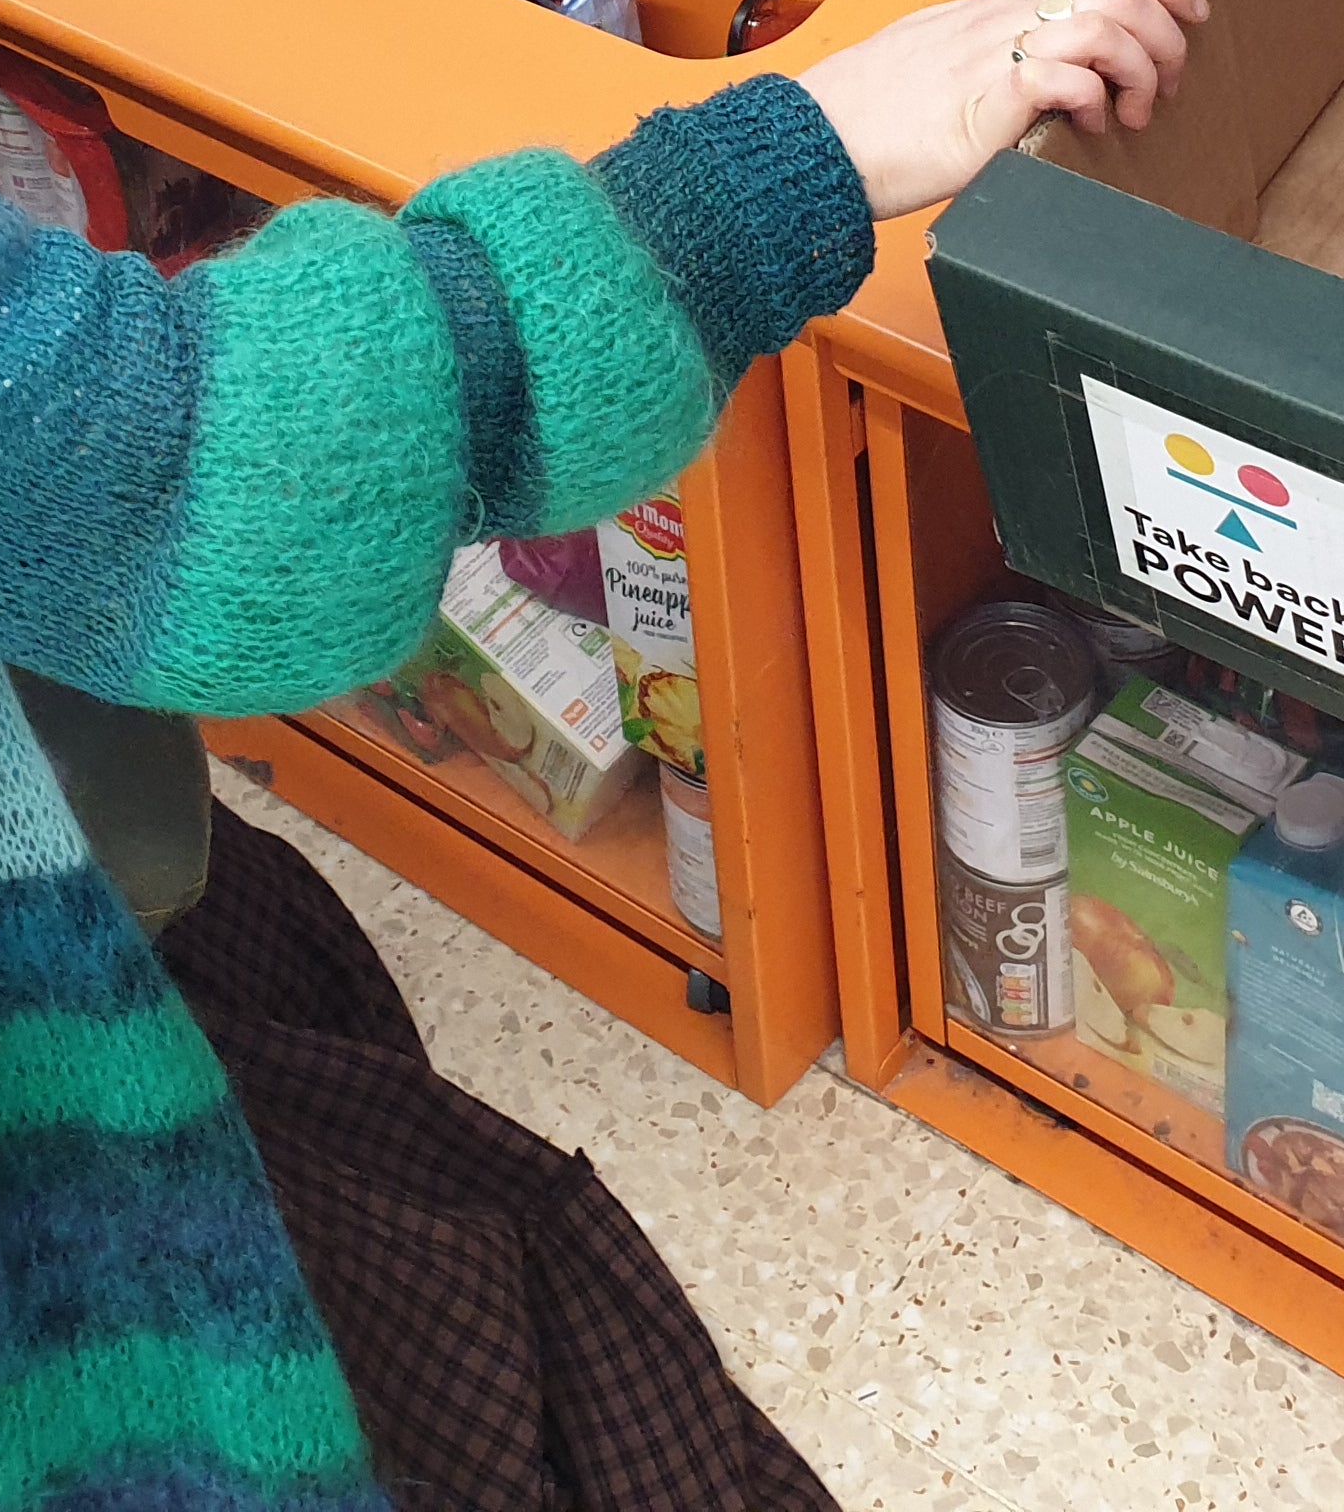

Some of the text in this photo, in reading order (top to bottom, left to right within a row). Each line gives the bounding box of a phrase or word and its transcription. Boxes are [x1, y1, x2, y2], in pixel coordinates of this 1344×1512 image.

[1124, 505, 1230, 573] Take
[626, 560, 660, 581] 100%
[632, 607, 676, 632] juice
[1090, 806, 1156, 845] APPLE
[1163, 840, 1220, 881] JUICE
[963, 886, 1006, 915] BEEF
